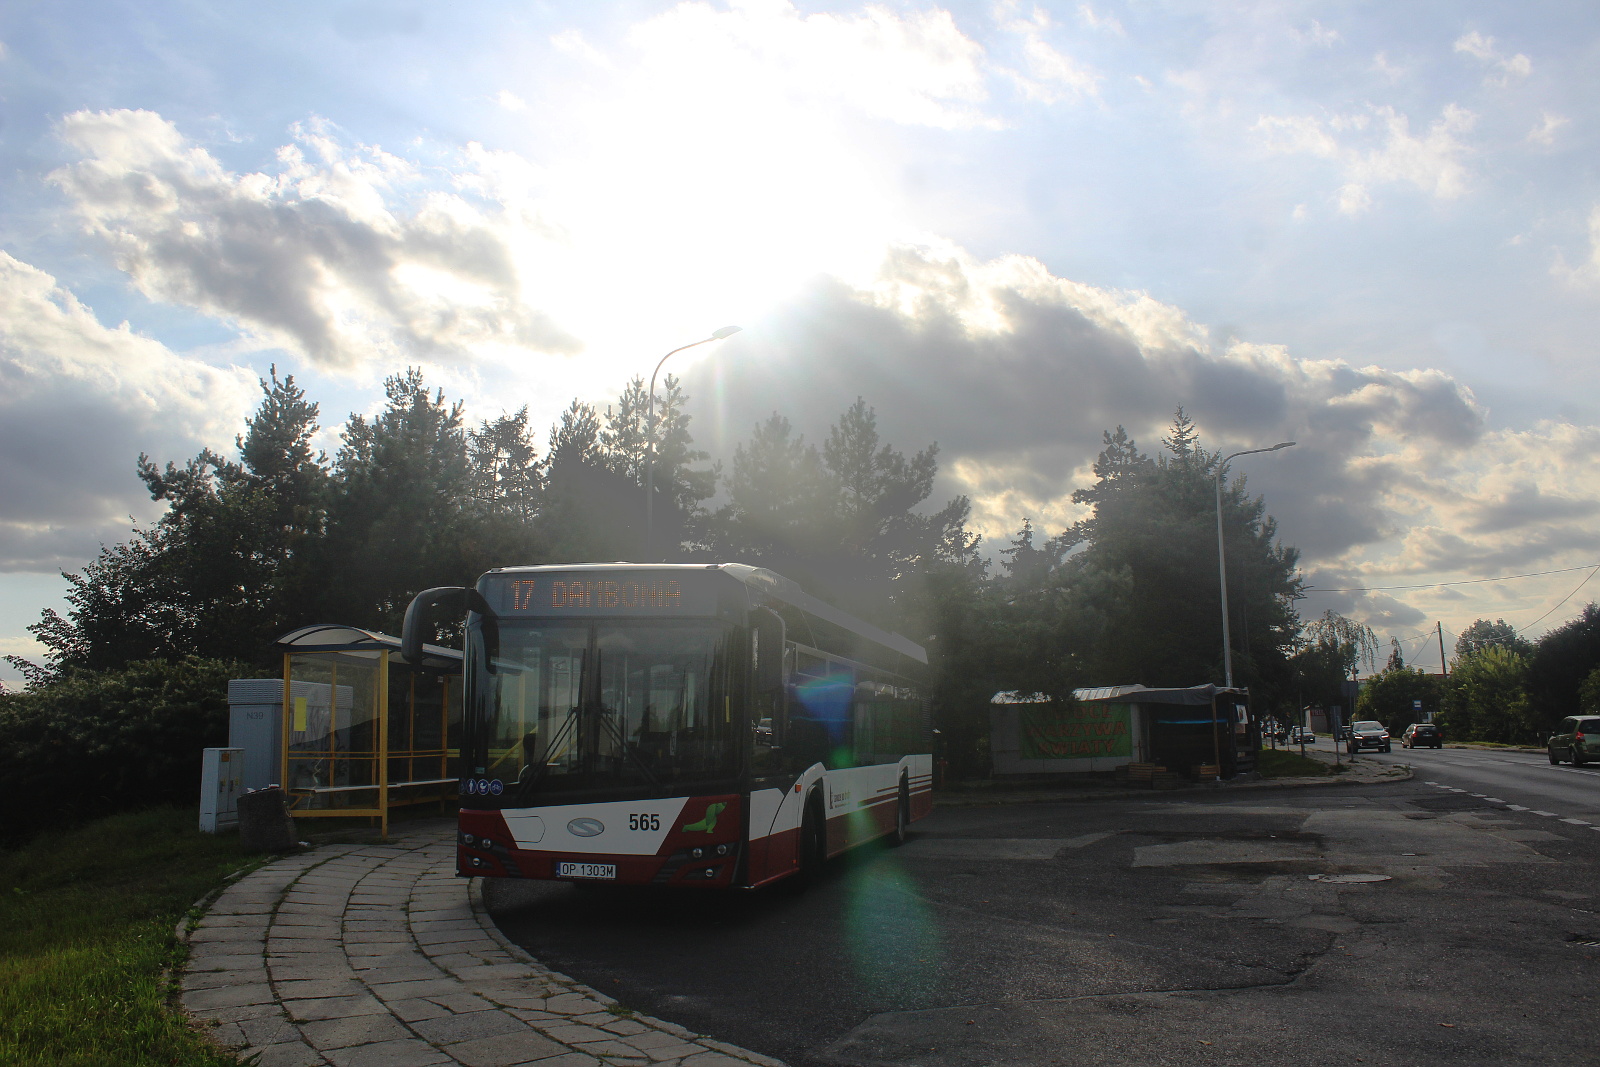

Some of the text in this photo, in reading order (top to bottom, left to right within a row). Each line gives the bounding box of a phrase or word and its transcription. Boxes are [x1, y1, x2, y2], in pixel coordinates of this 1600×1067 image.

[511, 580, 681, 610] 17 DAMBONIA
[1040, 703, 1112, 720] OCE
[1025, 721, 1128, 738] WARZYWA
[1038, 739, 1116, 755] KWIATY
[629, 813, 660, 831] 565
[562, 863, 613, 877] OP 1303M
